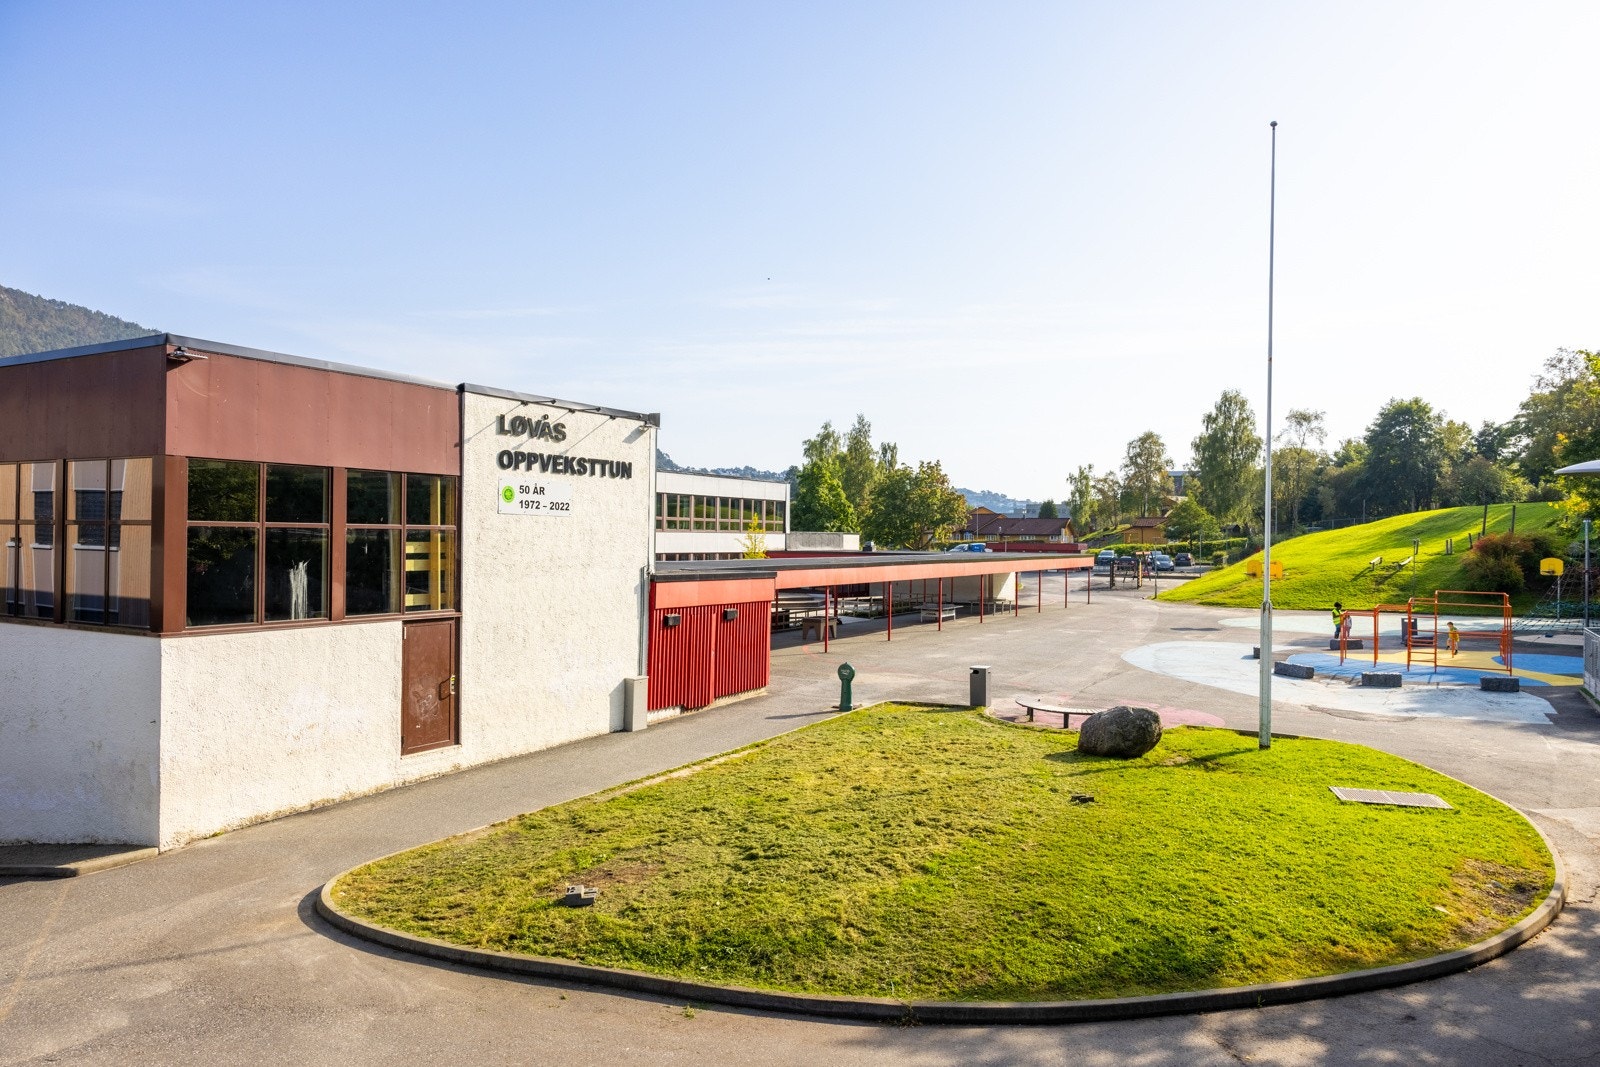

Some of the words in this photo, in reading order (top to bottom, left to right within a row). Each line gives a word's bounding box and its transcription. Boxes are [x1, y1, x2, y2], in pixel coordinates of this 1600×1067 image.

[497, 414, 566, 442] LØVÅS
[498, 450, 632, 479] OPPVEKSTTUN
[519, 485, 530, 495] 50
[532, 483, 545, 496] ÅR
[519, 500, 541, 510] 1972
[549, 501, 570, 511] 2022
